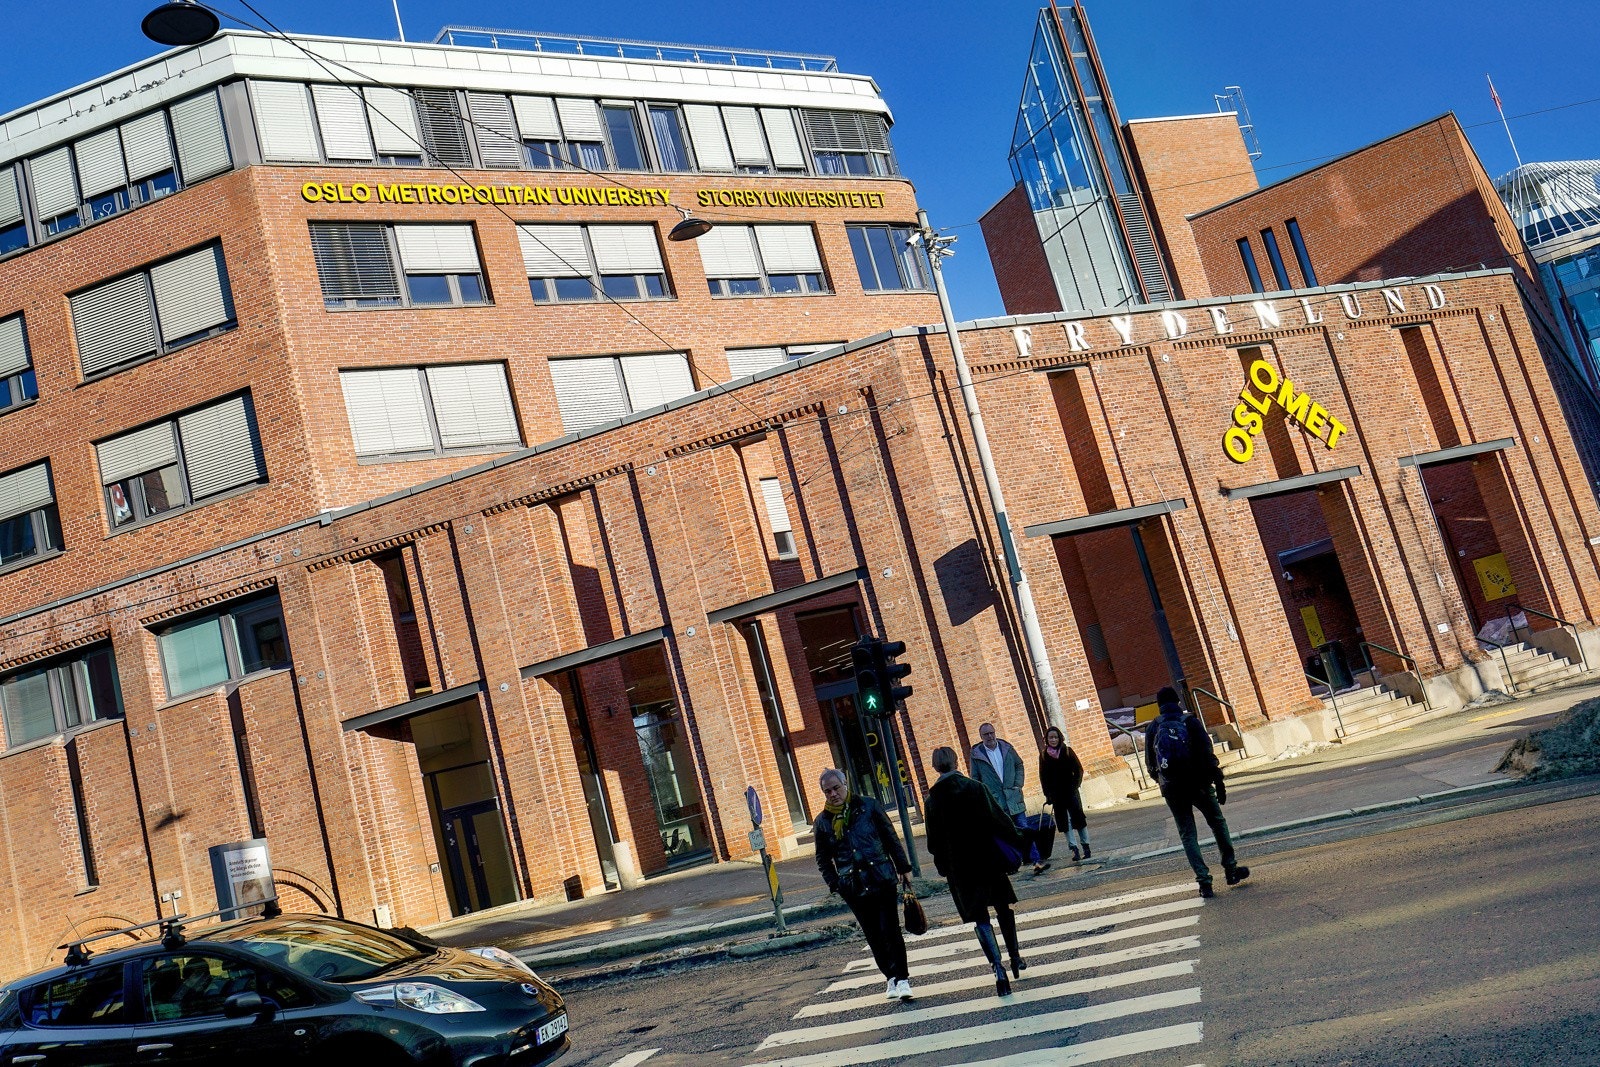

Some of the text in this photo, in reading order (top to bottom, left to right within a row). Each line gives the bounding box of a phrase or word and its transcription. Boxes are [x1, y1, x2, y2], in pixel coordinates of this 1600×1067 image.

[301, 182, 671, 206] OSLO METROPOLITAN UNIVERSITY
[697, 189, 885, 207] STORBYUNIVERSITETET
[1010, 285, 1447, 358] FRYDENLUND
